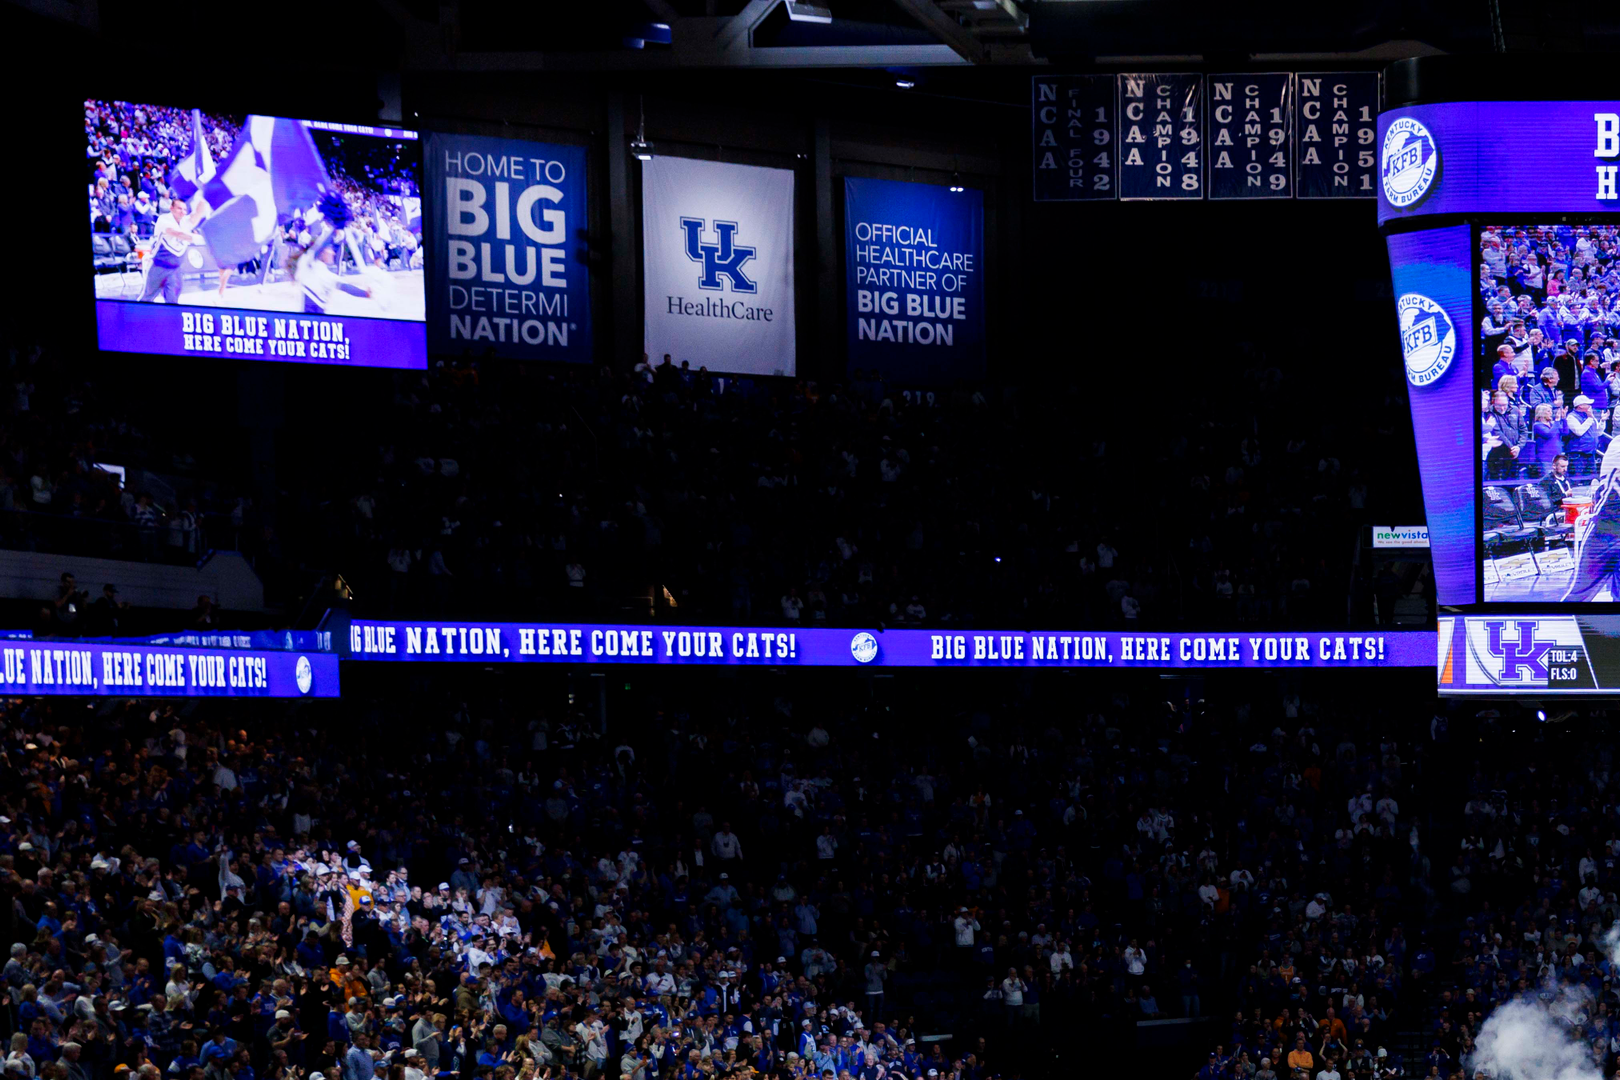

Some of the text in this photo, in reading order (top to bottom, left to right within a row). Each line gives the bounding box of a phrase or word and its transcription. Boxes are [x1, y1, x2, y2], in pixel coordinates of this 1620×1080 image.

[1124, 79, 1145, 167] NCAA
[1155, 84, 1171, 187] CHAMPION
[1212, 82, 1234, 169] NCAA
[1245, 84, 1261, 187] CHAMPION
[1301, 78, 1323, 166] NCAA
[1332, 84, 1349, 187] CHAMPION
[1384, 120, 1422, 150] KENTUCKY
[1093, 106, 1110, 191] 1942
[1180, 106, 1199, 191] 1948
[1268, 106, 1287, 191] 1949
[1357, 106, 1375, 191] 1951
[1391, 147, 1418, 176] KFB
[445, 150, 567, 184] HOME TO
[1401, 167, 1433, 203] BUREAU
[446, 177, 567, 245] BIG
[856, 222, 938, 248] OFFICIAL
[448, 240, 568, 289] BLUE
[680, 216, 757, 294] UK
[856, 245, 974, 273] HEALTHCARE
[856, 266, 967, 292] PARTNER OF
[449, 287, 569, 318] DETERMI
[667, 296, 774, 326] HealthCare
[858, 290, 966, 320] BIG BLUE
[182, 312, 350, 343] BIG BLUE NATION,
[858, 317, 954, 348] NATION
[1404, 324, 1433, 352] KFB
[184, 335, 350, 361] HERE COME YOUR CATS!
[1418, 345, 1452, 384] BUREAU
[1377, 530, 1429, 540] newvista
[364, 626, 796, 659] BLUE NATION, HERE COME YOUR CATS!
[931, 635, 1385, 664] BIG BLUE NATION, HERE COME YOUR CATS!
[1484, 620, 1549, 681] UK
[1551, 650, 1577, 663] TOL:4
[30, 649, 267, 690] NATION, HERE COME YOUR CATS!
[1550, 668, 1577, 681] FLS:0
